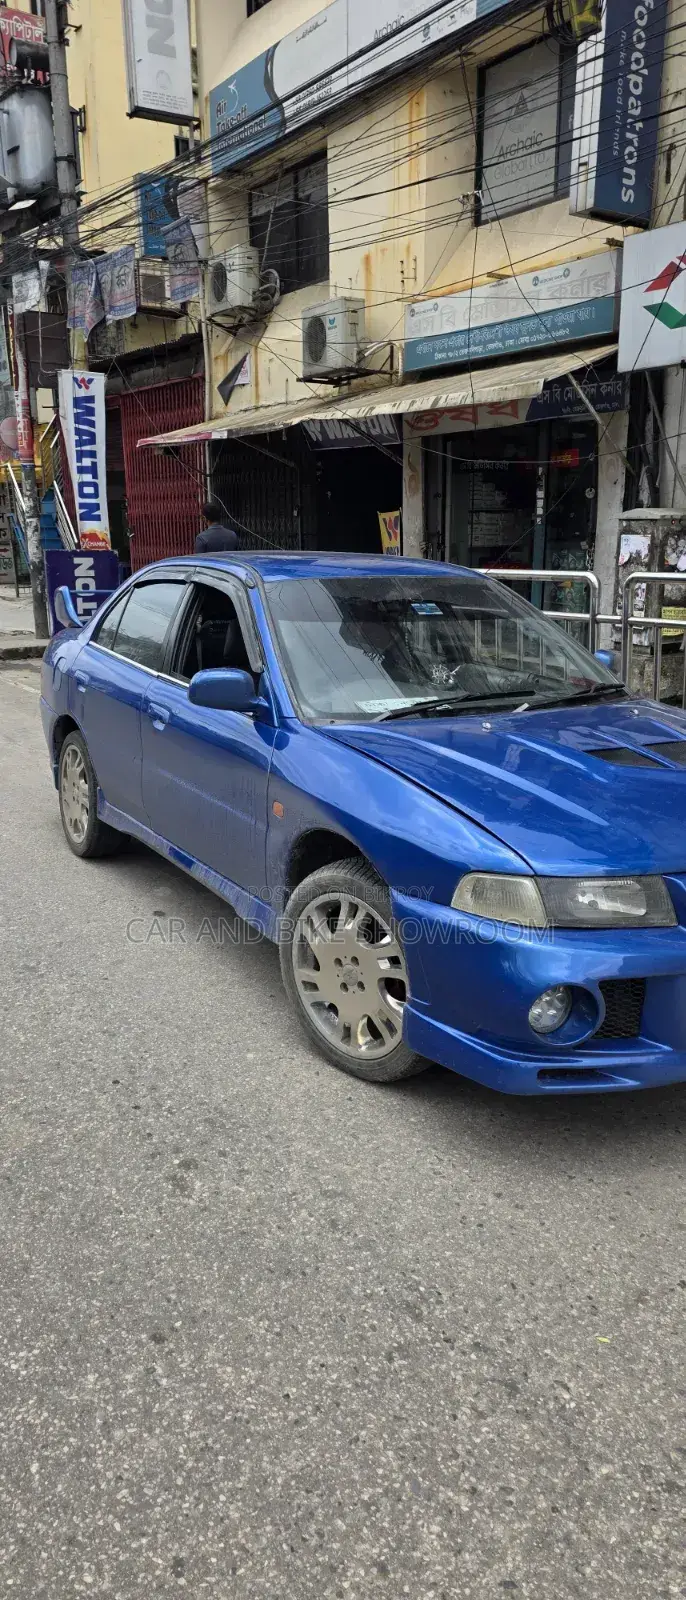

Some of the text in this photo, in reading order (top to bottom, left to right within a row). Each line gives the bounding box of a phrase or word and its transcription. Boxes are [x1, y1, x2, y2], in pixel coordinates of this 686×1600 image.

[373, 14, 405, 42] Archaic
[215, 99, 228, 117] Air
[216, 104, 248, 134] Take-off
[498, 130, 544, 161] Archaic
[73, 395, 101, 521] WALTON
